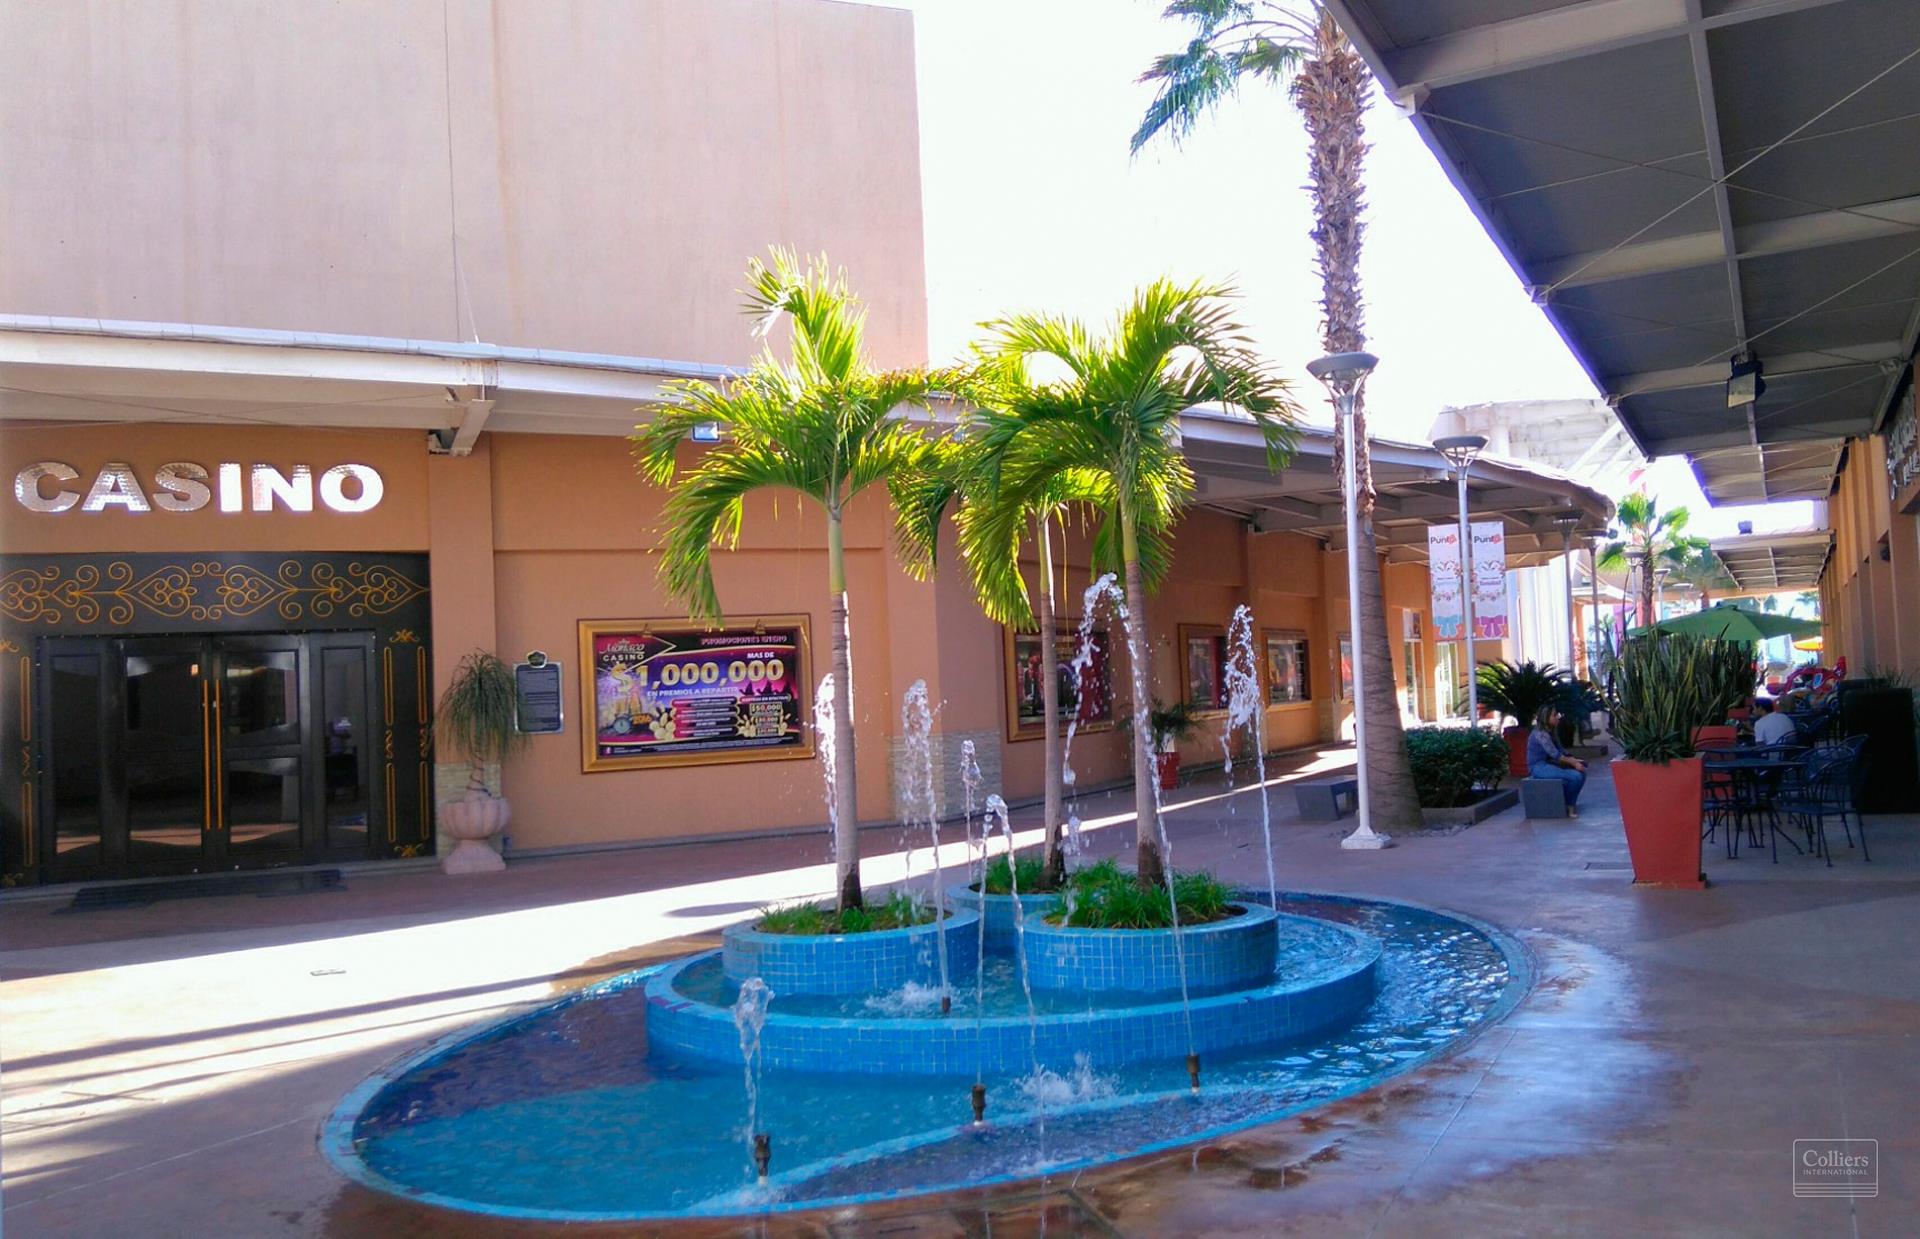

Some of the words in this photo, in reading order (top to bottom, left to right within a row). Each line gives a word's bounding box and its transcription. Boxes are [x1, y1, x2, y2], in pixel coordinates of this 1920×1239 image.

[15, 462, 384, 513] CASINO
[603, 653, 644, 661] CASINO
[659, 688, 693, 697] PREMIOS
